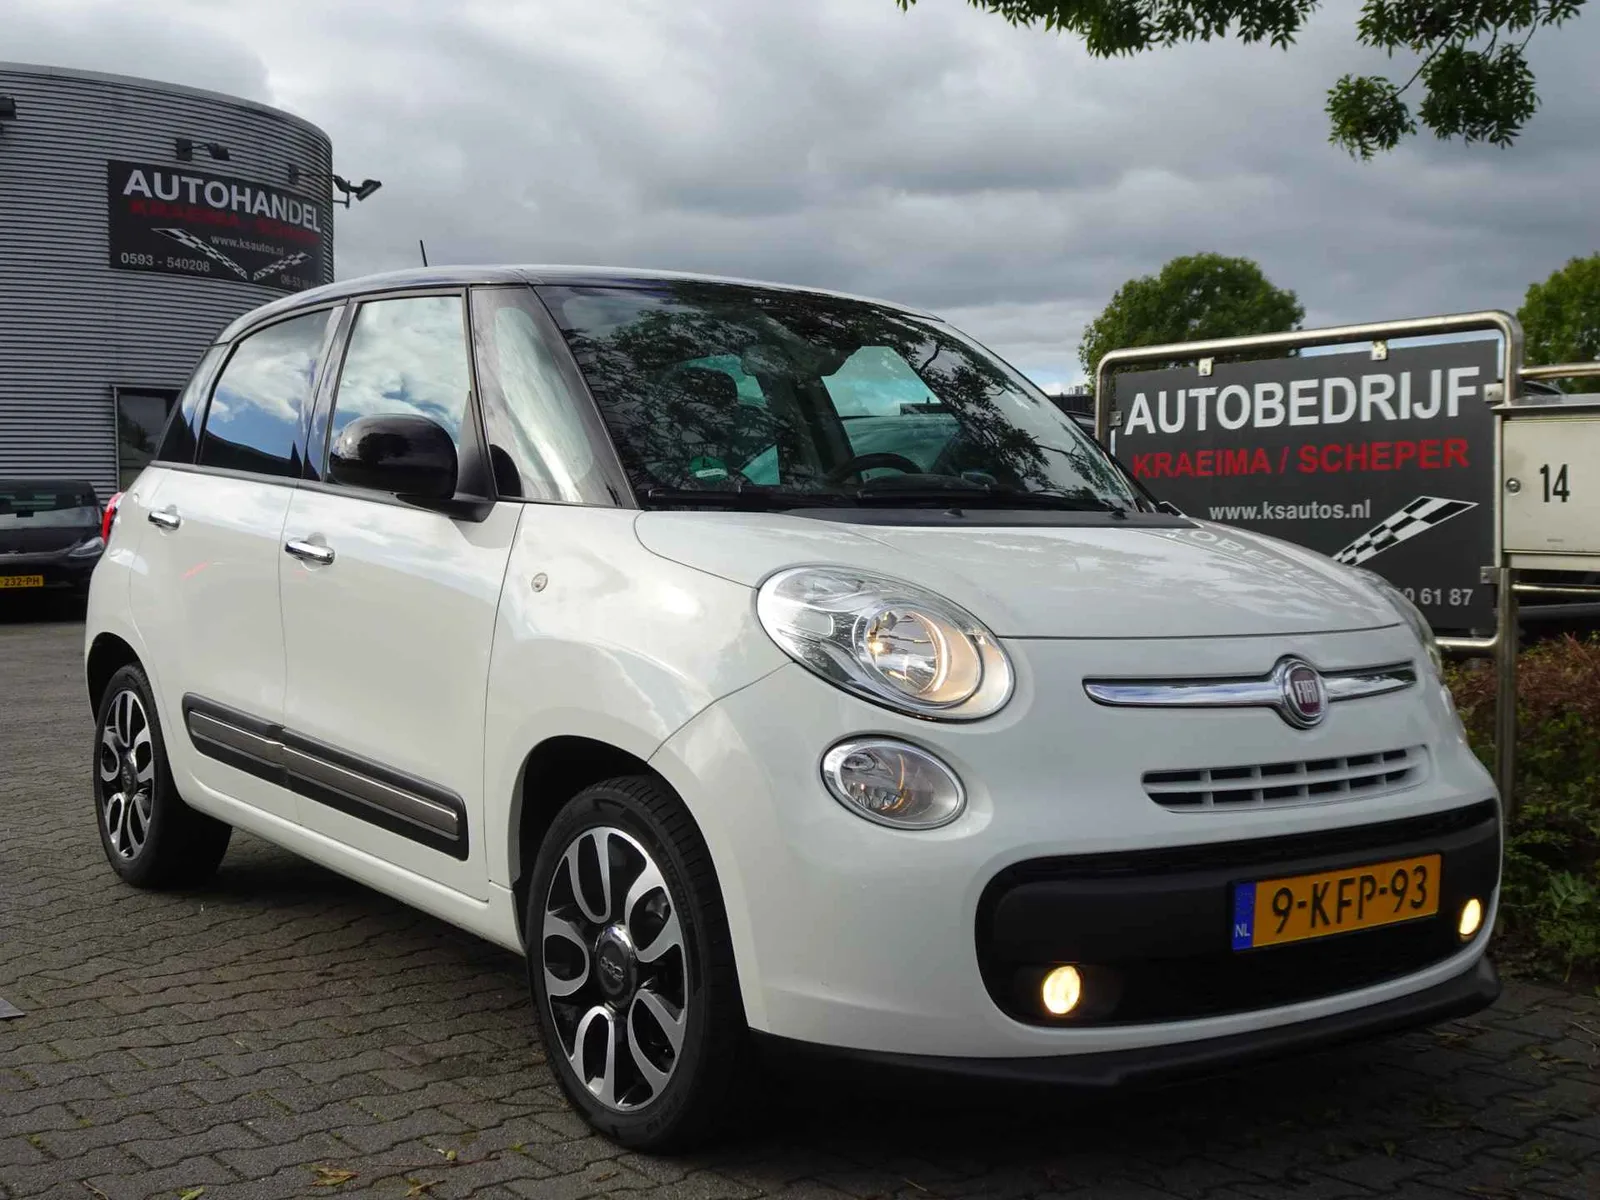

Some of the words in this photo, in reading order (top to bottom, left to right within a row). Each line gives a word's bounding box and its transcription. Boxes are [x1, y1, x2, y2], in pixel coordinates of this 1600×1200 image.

[123, 169, 321, 233] AUTOHANDEL
[210, 234, 285, 255] www.ksautos.nl
[120, 252, 154, 266] 0593
[166, 256, 211, 272] 540208
[1123, 366, 1480, 436] AUTOBEDRIJF
[1132, 447, 1272, 480] KRAEIMA
[1278, 446, 1289, 474] /
[1299, 437, 1470, 474] SCHEPER
[1539, 463, 1571, 503] 14
[1209, 498, 1371, 521] www.ksautos.nl
[1420, 587, 1442, 605] 61
[1448, 588, 1474, 606] 87
[1294, 679, 1319, 704] FIAT
[1271, 865, 1428, 934] 9-KFP-93
[1235, 923, 1251, 938] NL
